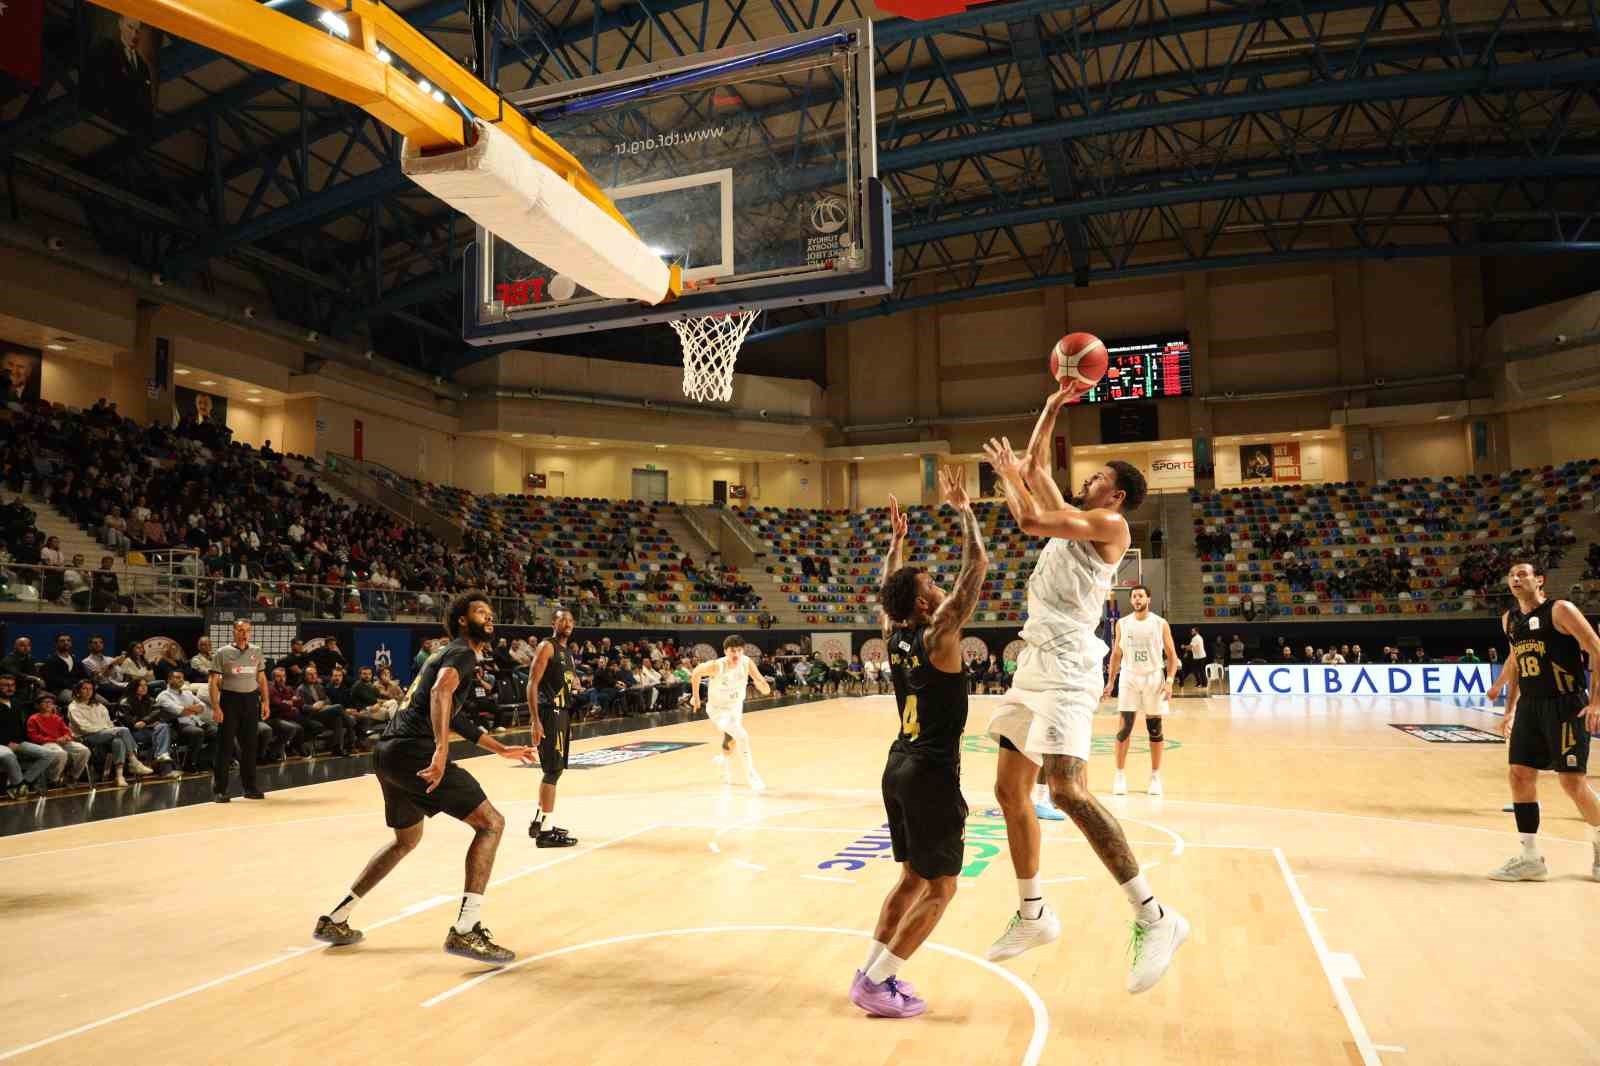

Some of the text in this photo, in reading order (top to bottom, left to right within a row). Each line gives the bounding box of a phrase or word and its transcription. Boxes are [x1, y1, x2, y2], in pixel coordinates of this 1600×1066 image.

[1519, 655, 1541, 678] 18
[1237, 667, 1486, 693] ACIBADEM
[903, 694, 920, 741] 4
